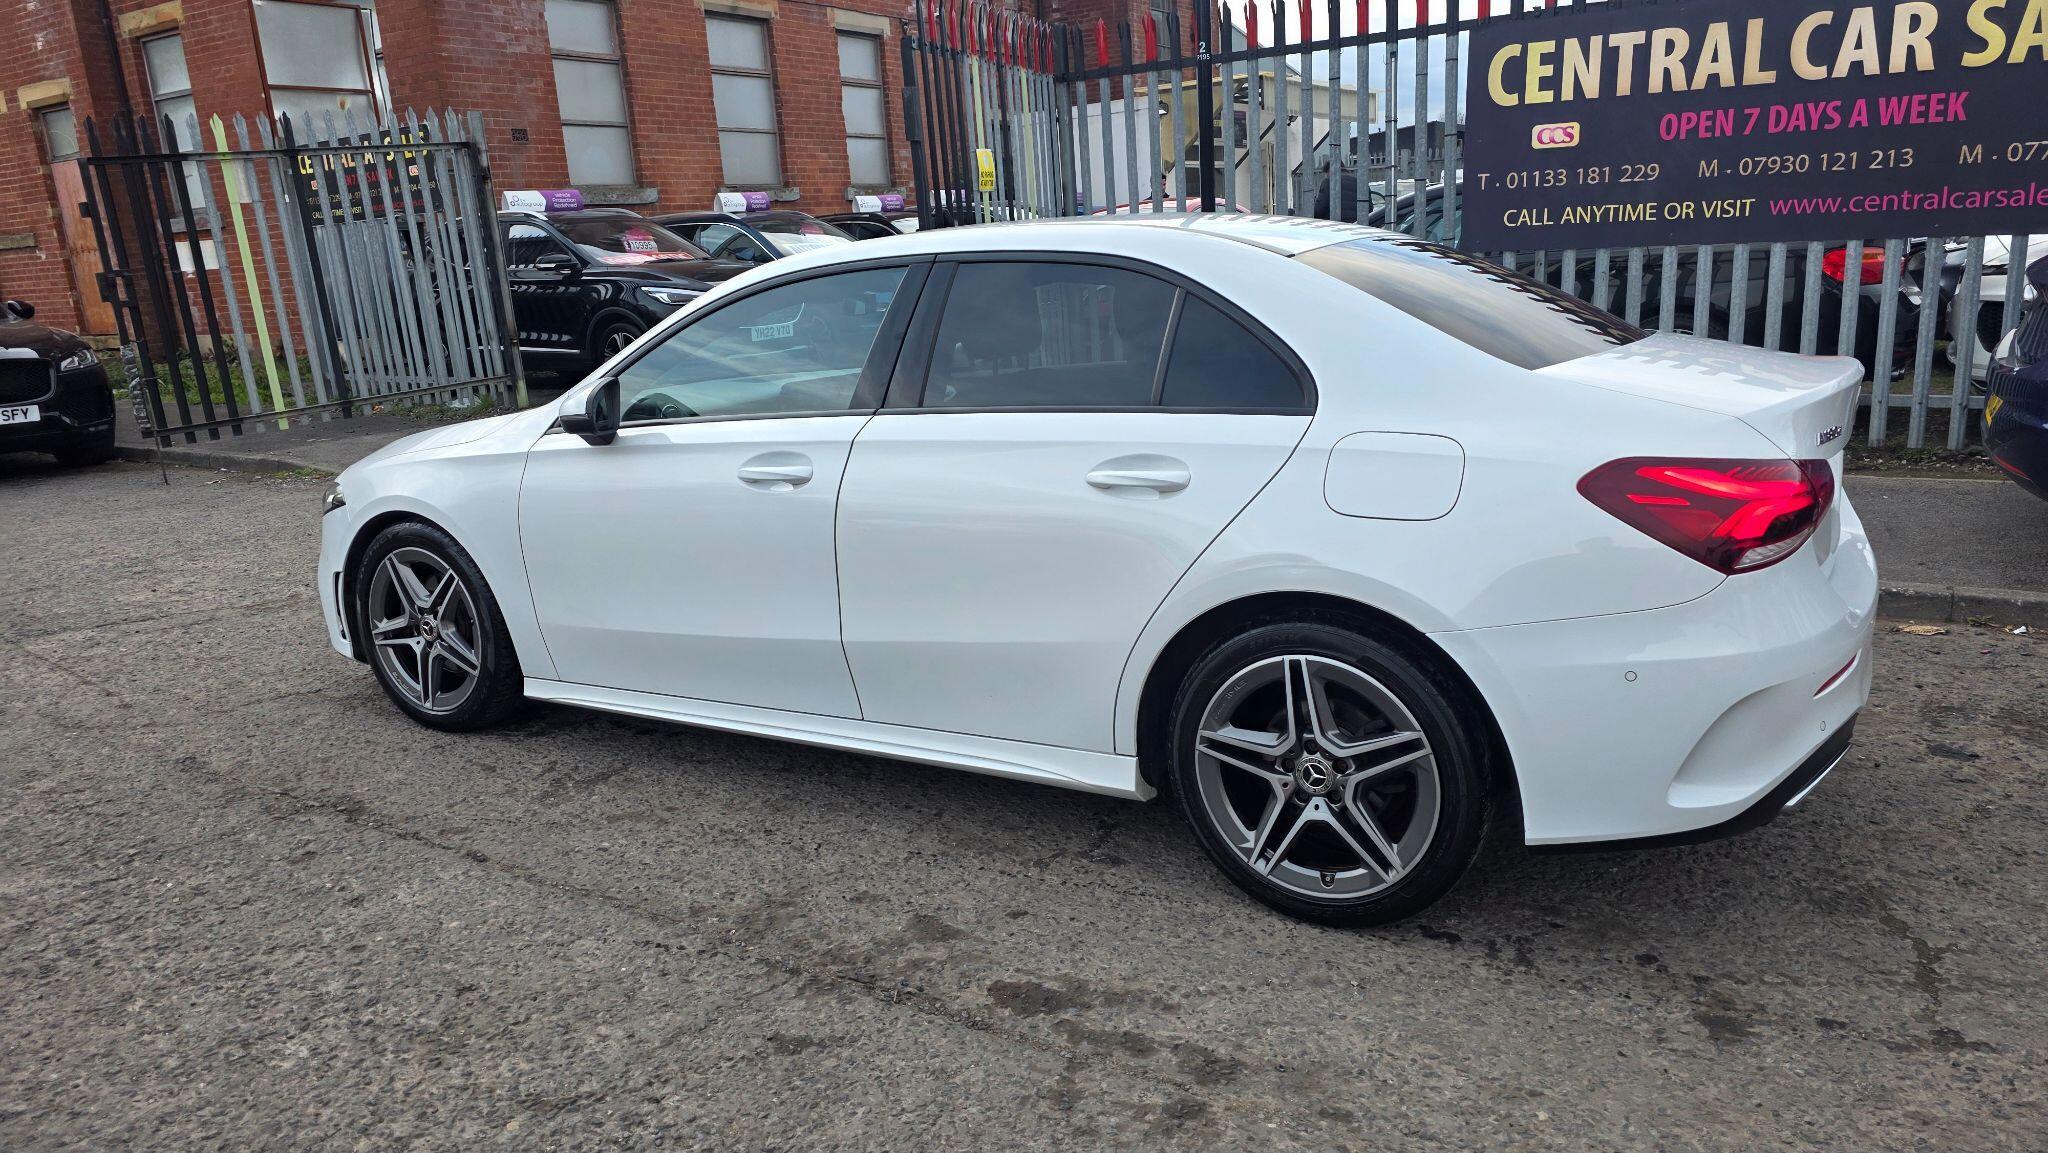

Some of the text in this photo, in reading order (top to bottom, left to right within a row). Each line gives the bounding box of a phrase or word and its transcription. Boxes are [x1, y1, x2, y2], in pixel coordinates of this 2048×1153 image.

[1487, 17, 1777, 107] CENTRAL
[1790, 1, 1939, 81] CAR
[1659, 91, 1970, 142] OPEN 7 DAYS A WEEK
[1536, 125, 1575, 146] CCS
[1506, 168, 1568, 190] 01133
[1576, 165, 1611, 186] 181
[1619, 162, 1661, 183] 229
[1738, 153, 1811, 177] 07930
[1819, 151, 1859, 173] 121
[1867, 147, 1915, 169] 213
[1503, 181, 2048, 228] CALL ANYTIME OR VISIT www.centralcarsale
[1, 407, 29, 421] SFY
